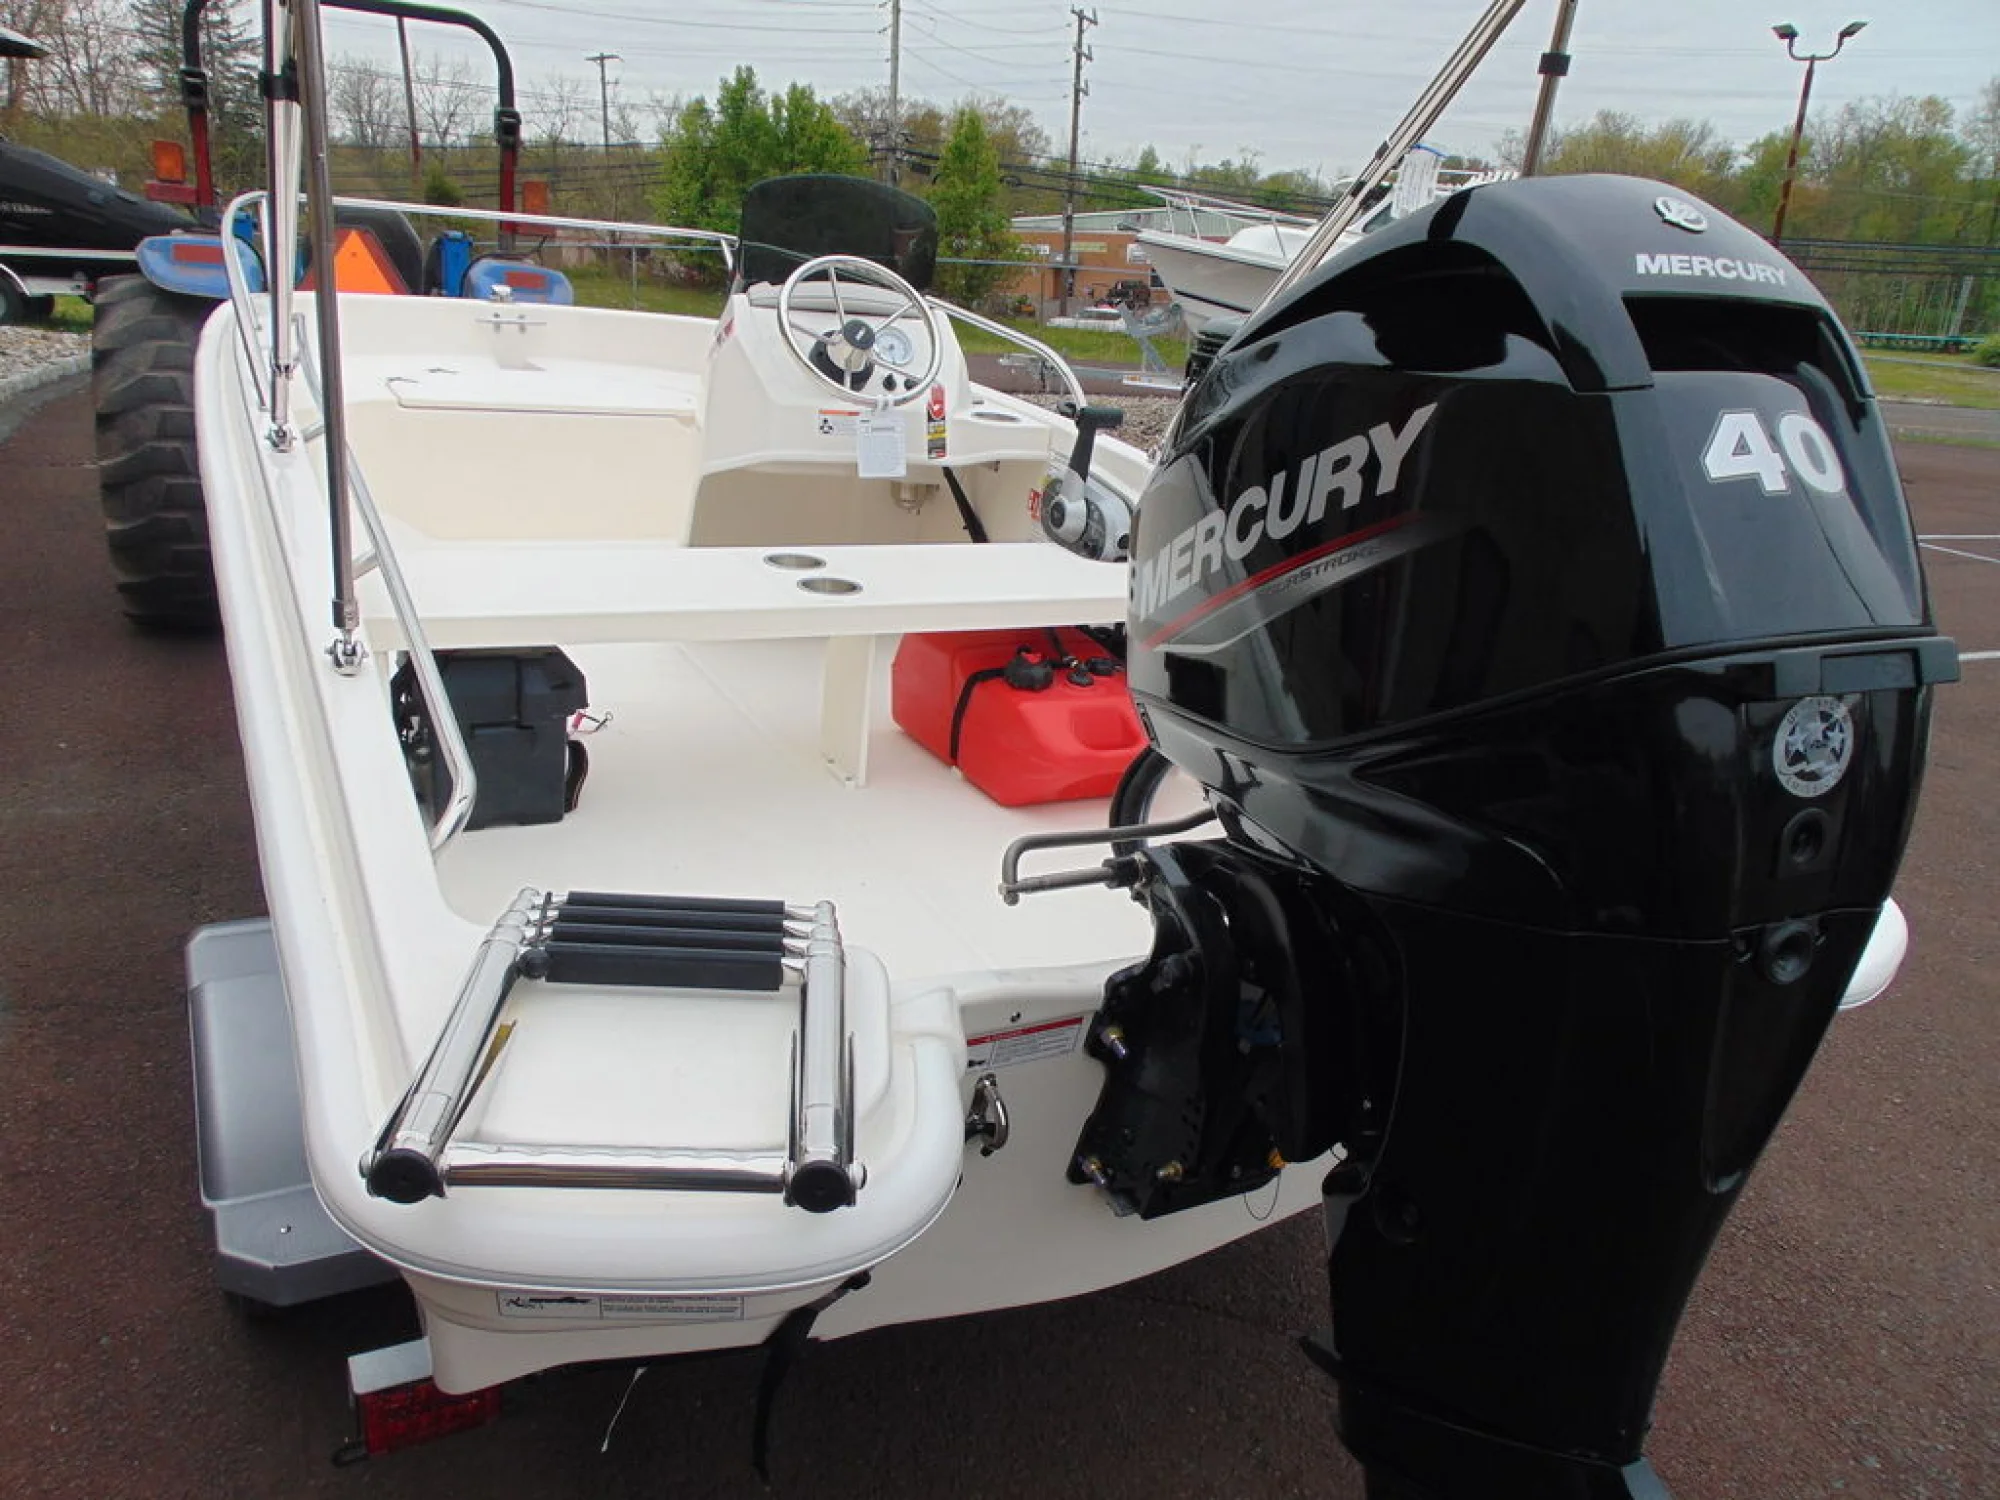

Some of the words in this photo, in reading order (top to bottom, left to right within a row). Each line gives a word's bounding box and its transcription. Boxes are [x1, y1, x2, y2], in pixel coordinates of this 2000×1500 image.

[1636, 253, 1786, 286] MERCURY
[1702, 410, 1845, 495] 40
[1138, 402, 1438, 621] MERCURY
